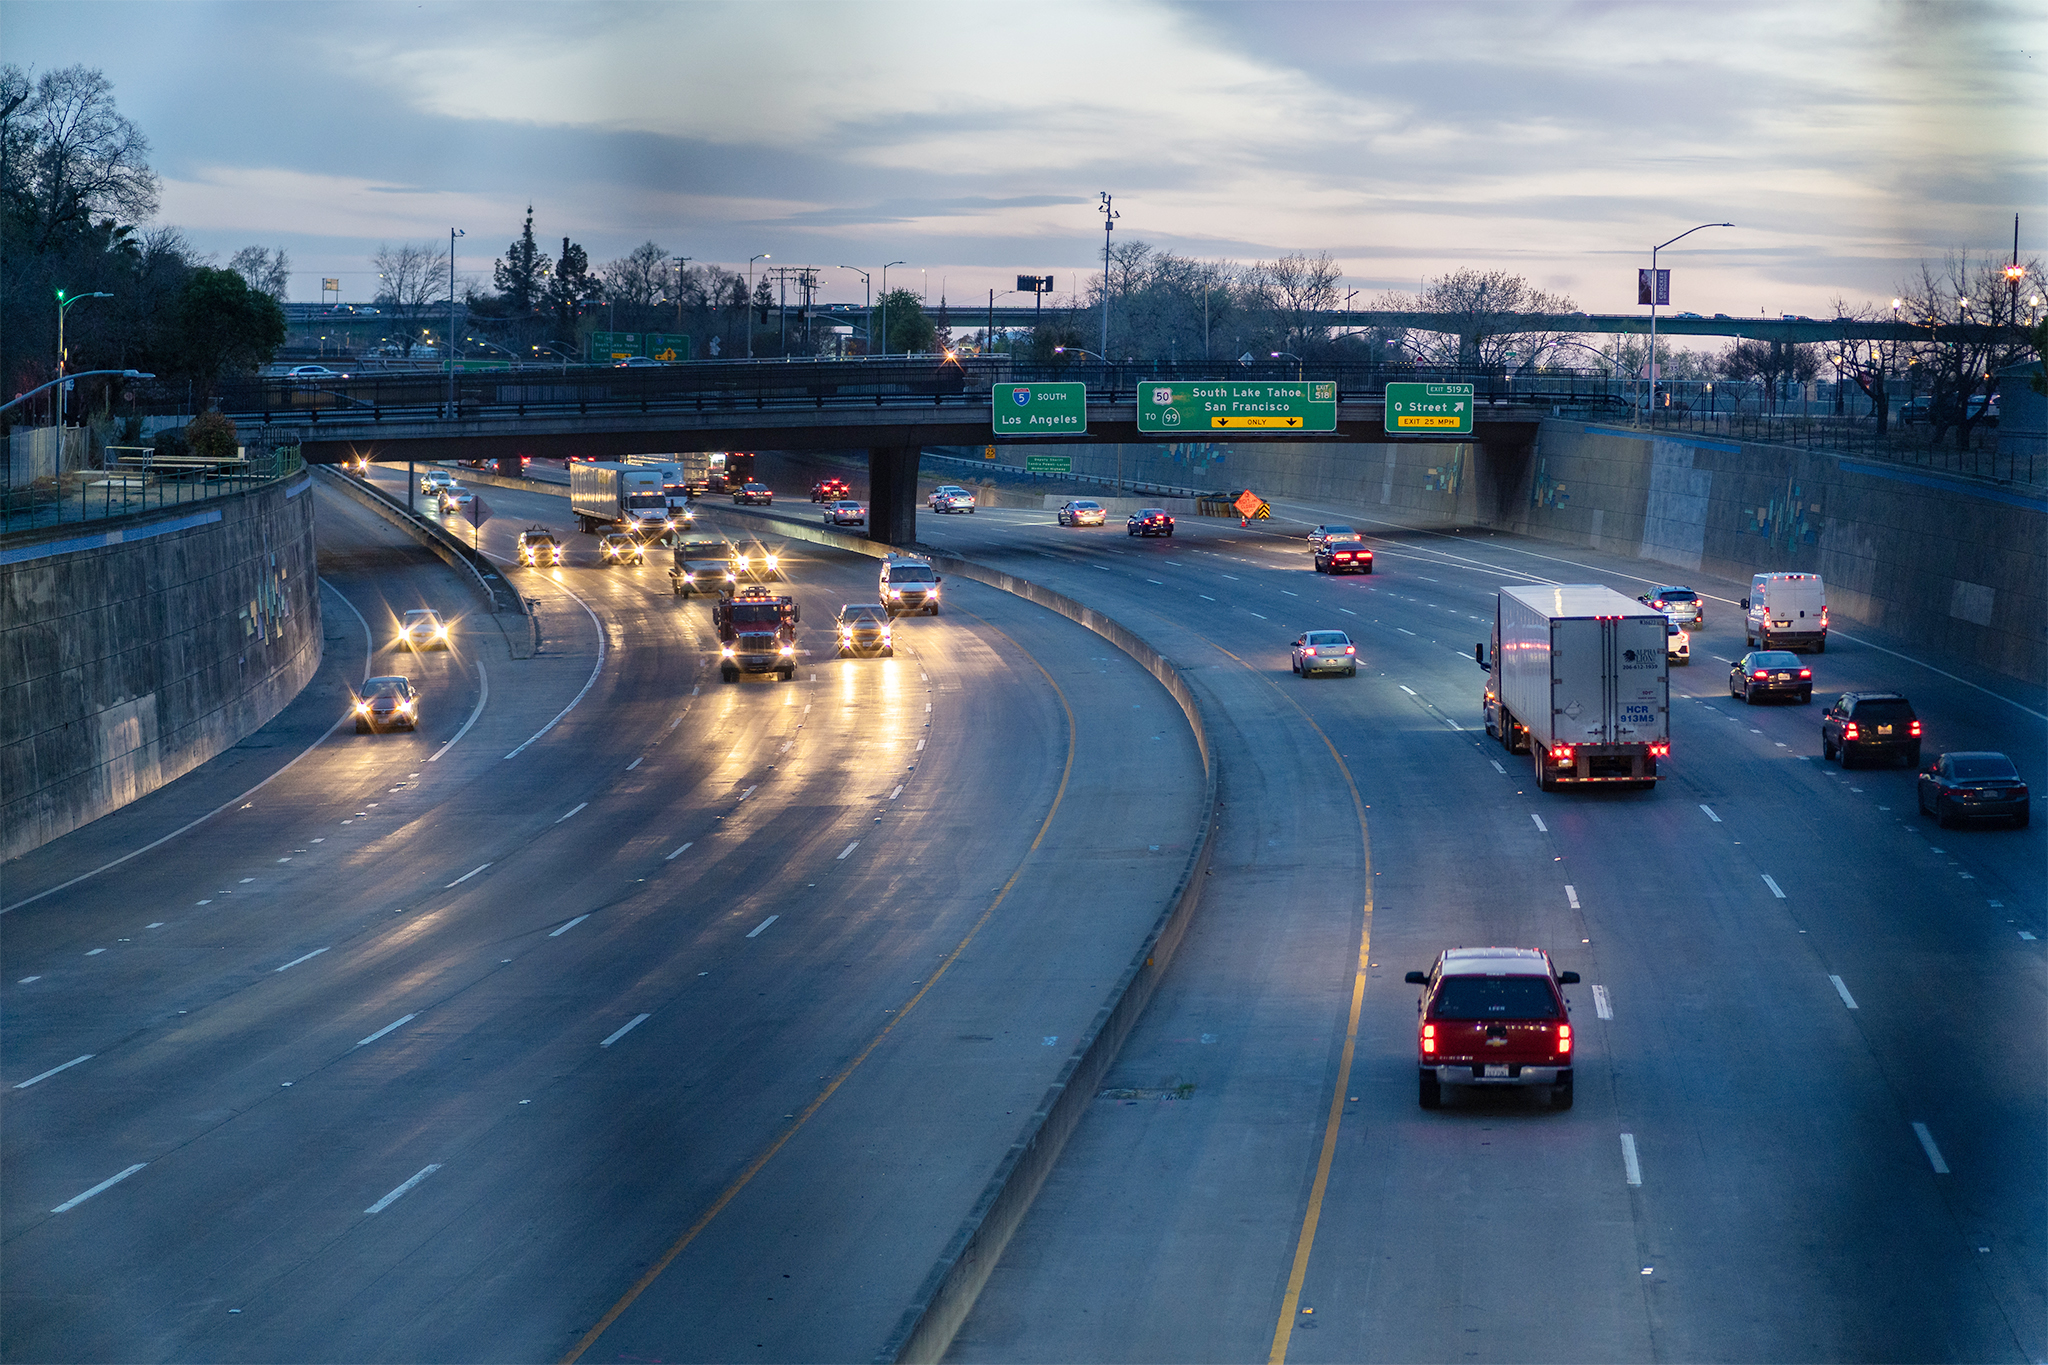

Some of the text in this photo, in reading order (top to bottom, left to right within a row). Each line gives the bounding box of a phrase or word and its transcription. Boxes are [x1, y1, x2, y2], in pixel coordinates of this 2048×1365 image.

[1157, 392, 1169, 401] 50
[1193, 388, 1301, 397] South Lake Tahoe
[1019, 394, 1024, 402] 5
[1205, 402, 1290, 411] San Francisco
[1395, 402, 1447, 412] Q Street
[1002, 415, 1077, 426] Los Angeles
[1165, 414, 1178, 422] 99
